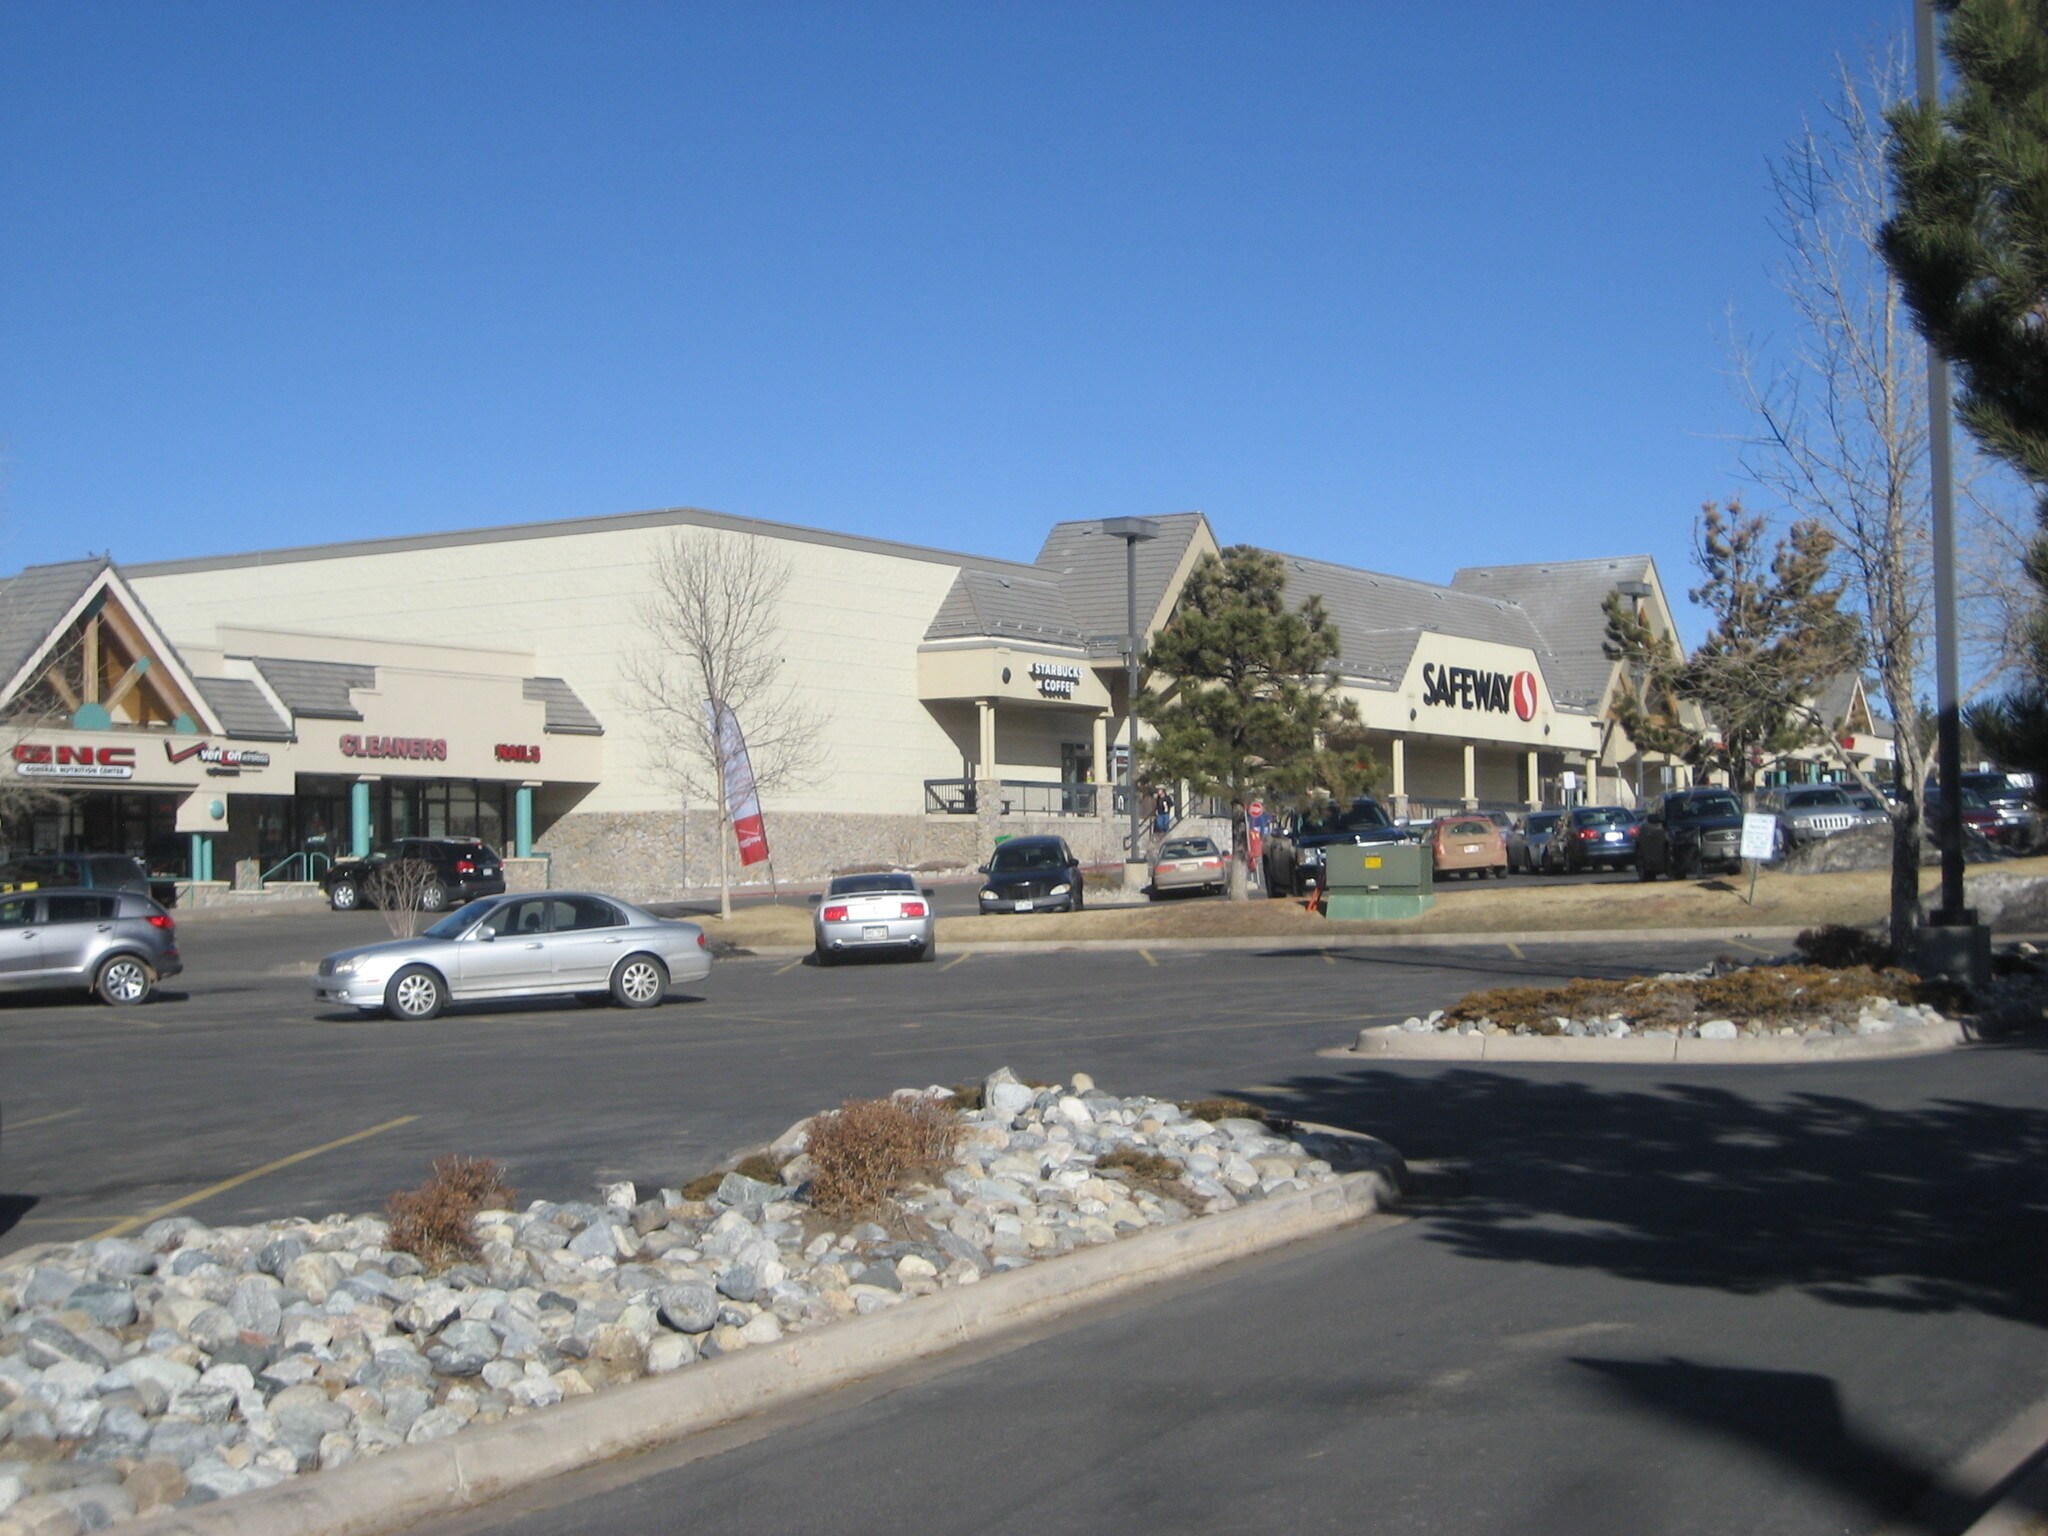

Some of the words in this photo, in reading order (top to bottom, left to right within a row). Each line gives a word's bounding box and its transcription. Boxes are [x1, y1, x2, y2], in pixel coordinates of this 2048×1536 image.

[1035, 663, 1083, 678] STARBUCKS
[1044, 679, 1075, 693] COFFEE
[1423, 663, 1513, 714] SAFEWAY
[13, 745, 136, 767] GNC
[200, 747, 241, 764] verizon
[340, 735, 447, 761] CLEANERS
[495, 744, 541, 763] NAILS
